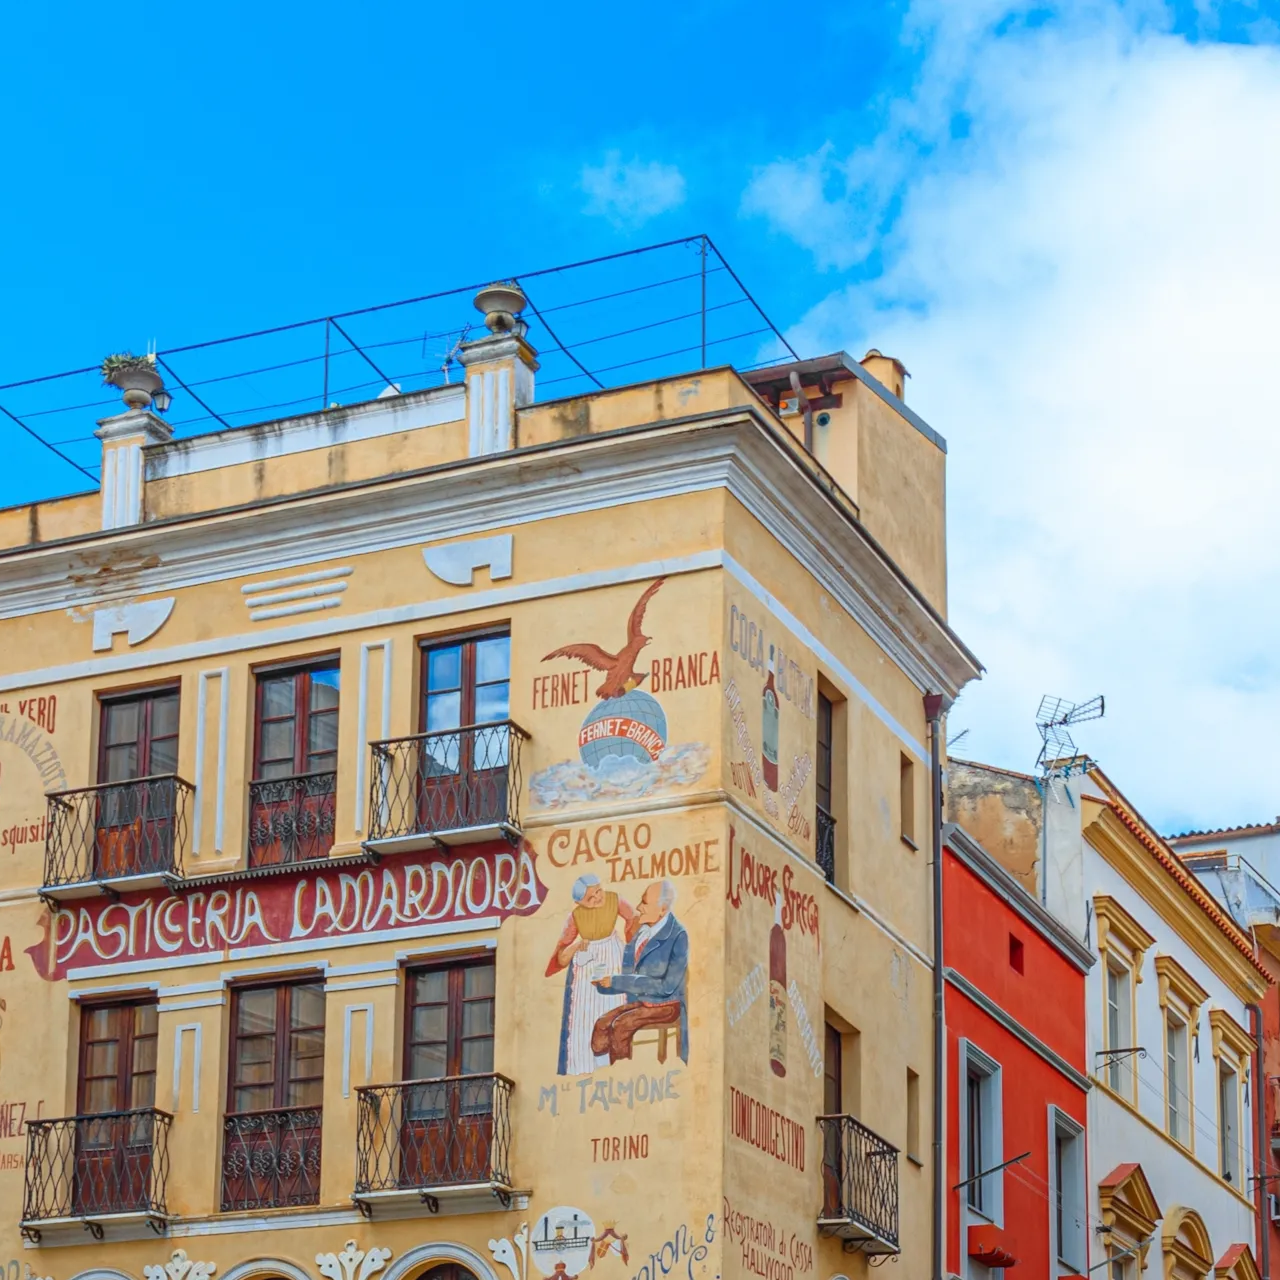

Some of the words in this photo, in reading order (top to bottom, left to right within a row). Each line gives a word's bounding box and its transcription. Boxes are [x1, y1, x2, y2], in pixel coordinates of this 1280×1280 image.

[730, 604, 765, 677] COCA
[532, 669, 592, 710] FERNET
[651, 650, 721, 693] BRANCA
[0, 703, 10, 714] IL
[19, 695, 57, 734] VERO
[547, 823, 652, 868] CACAO
[606, 838, 721, 884] TALMONE
[56, 889, 281, 964] PASTICCERIA
[289, 852, 544, 940] LAMARMORA
[577, 1069, 682, 1115] TALMONE
[591, 1134, 649, 1163] TORINO
[723, 1195, 776, 1253] REGISTRATORI
[790, 1233, 813, 1273] CASSA
